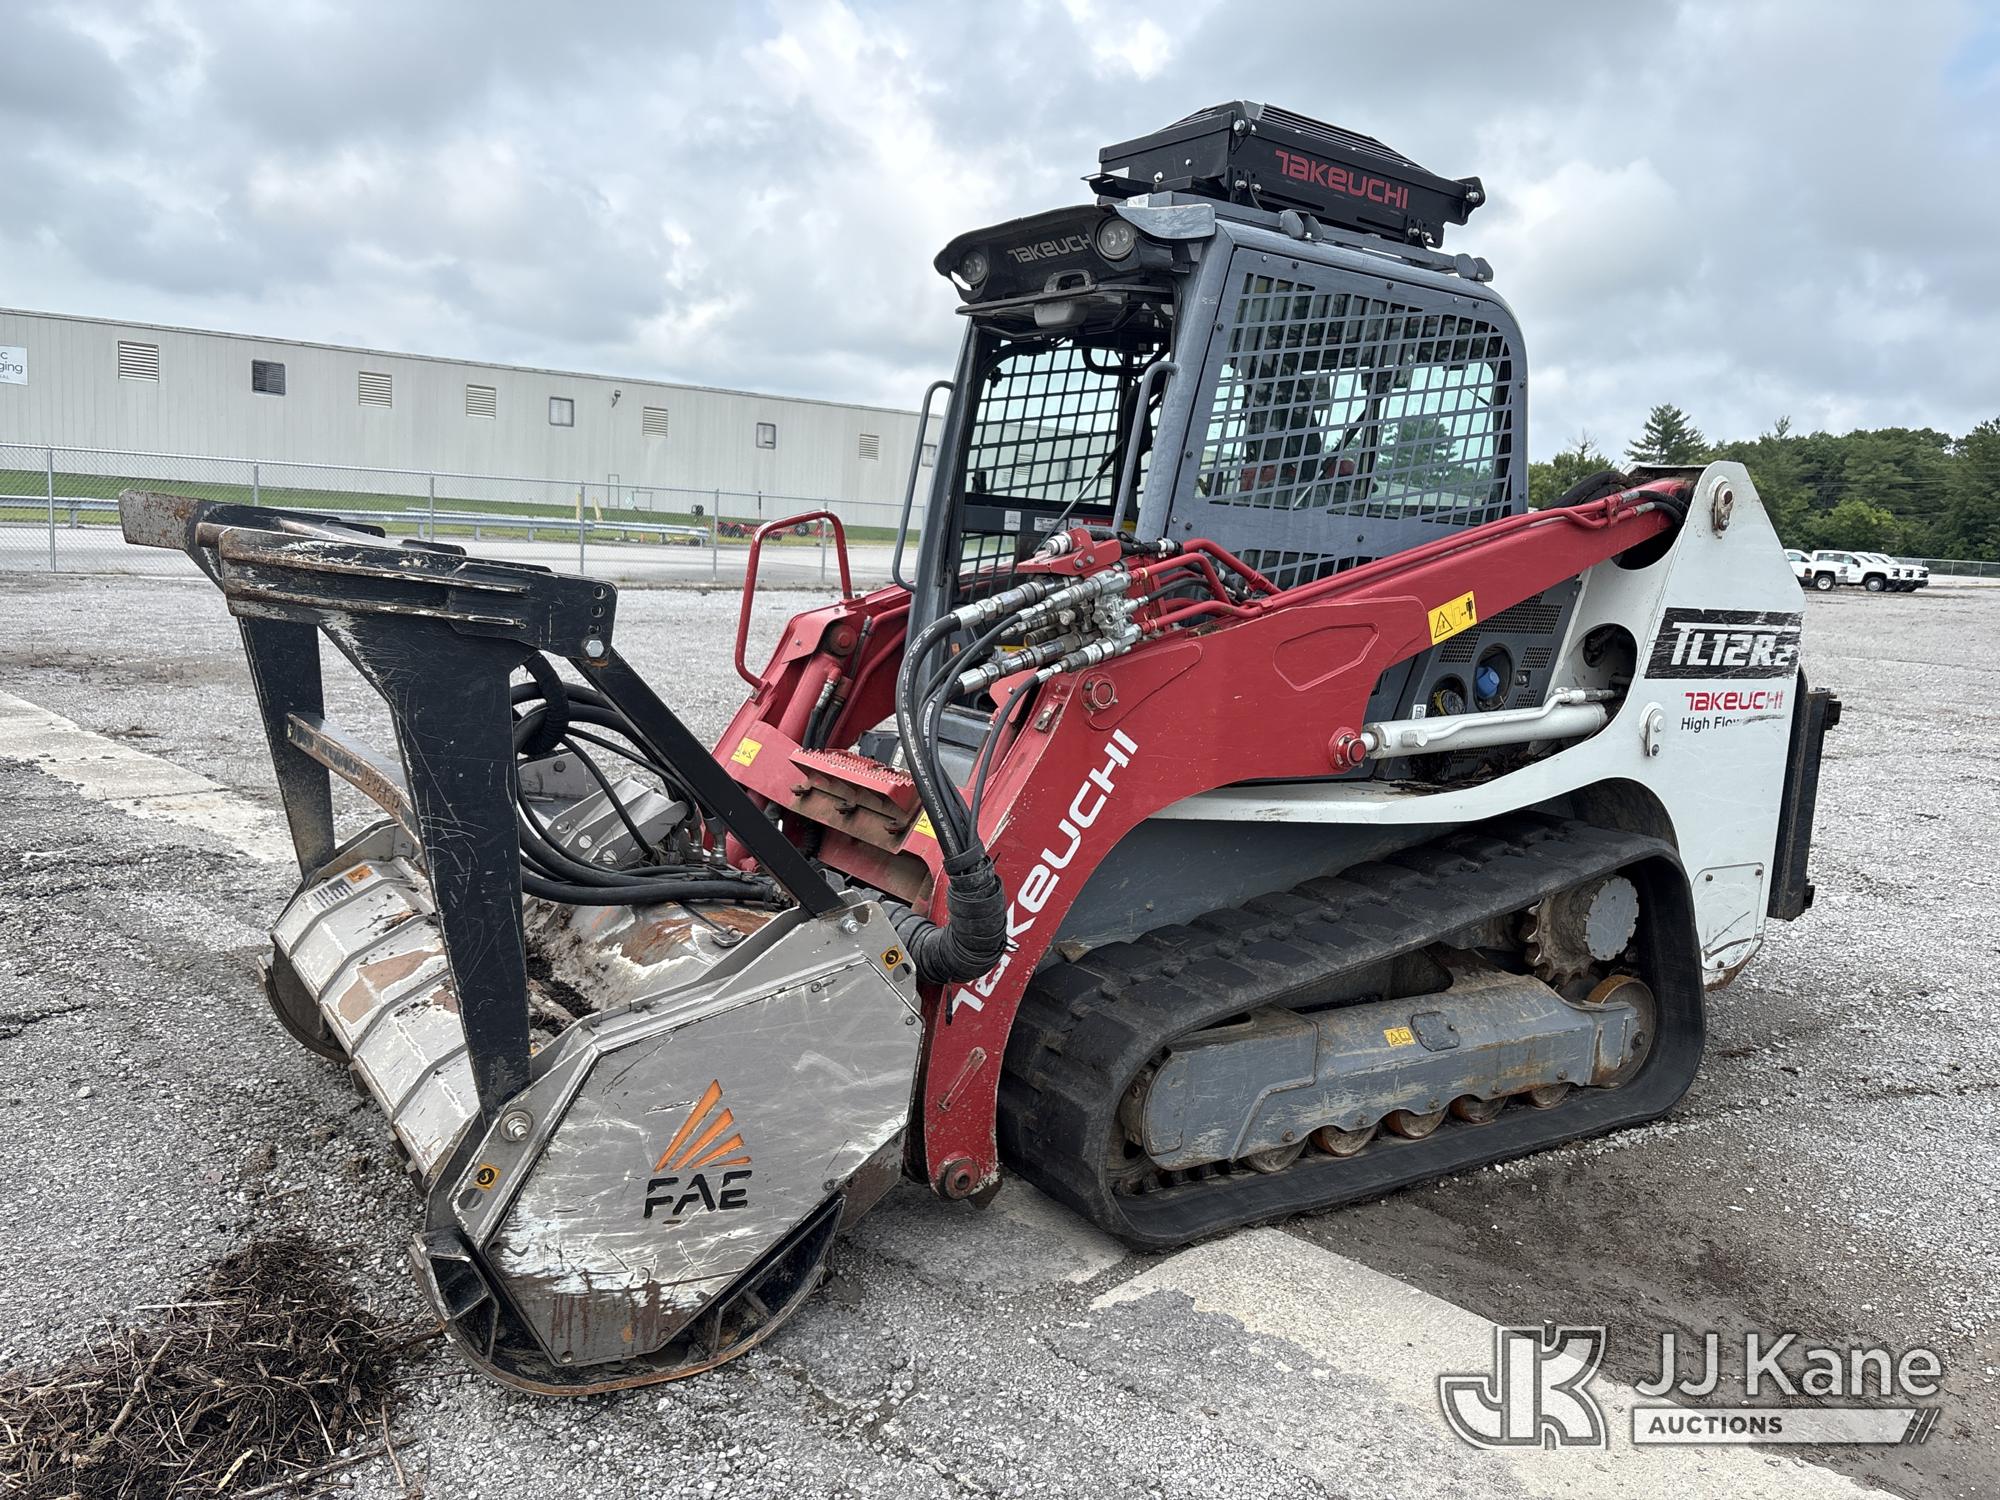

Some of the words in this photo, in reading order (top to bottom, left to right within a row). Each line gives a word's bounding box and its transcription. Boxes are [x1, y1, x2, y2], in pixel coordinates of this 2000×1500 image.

[1007, 233, 1093, 263] TAKEUCH
[1680, 716, 1710, 733] High
[643, 1170, 753, 1218] FAE
